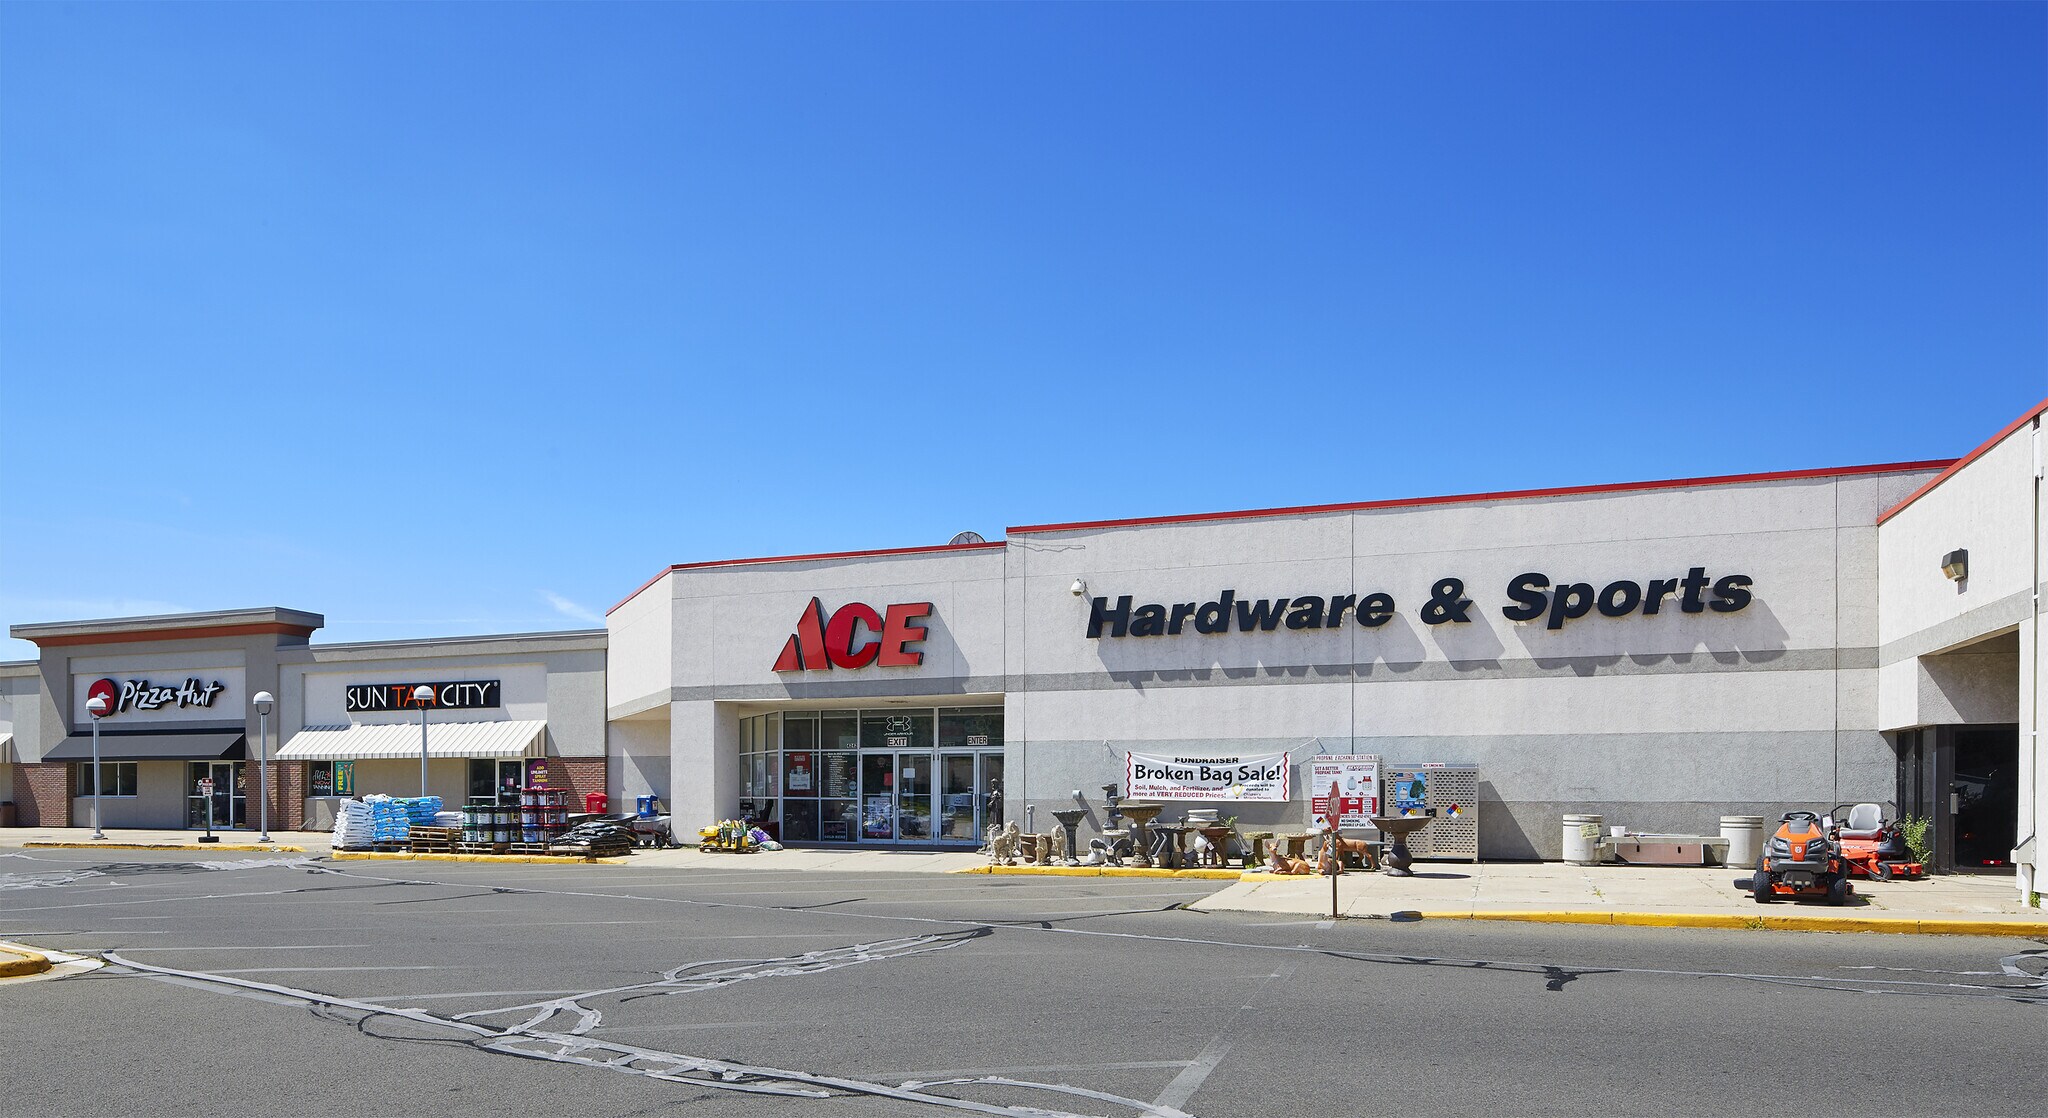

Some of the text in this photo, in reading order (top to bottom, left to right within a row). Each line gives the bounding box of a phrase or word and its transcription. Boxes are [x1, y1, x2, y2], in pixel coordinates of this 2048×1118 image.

[1086, 567, 1753, 638] Hardware & Sports
[771, 596, 933, 671] ACE
[118, 678, 222, 712] Pizza Hut
[347, 686, 387, 709] SUN
[441, 682, 491, 707] CITY
[888, 738, 907, 746] EXIT
[968, 736, 987, 745] ENTER
[1135, 764, 1281, 786] Broken Bag Sale!
